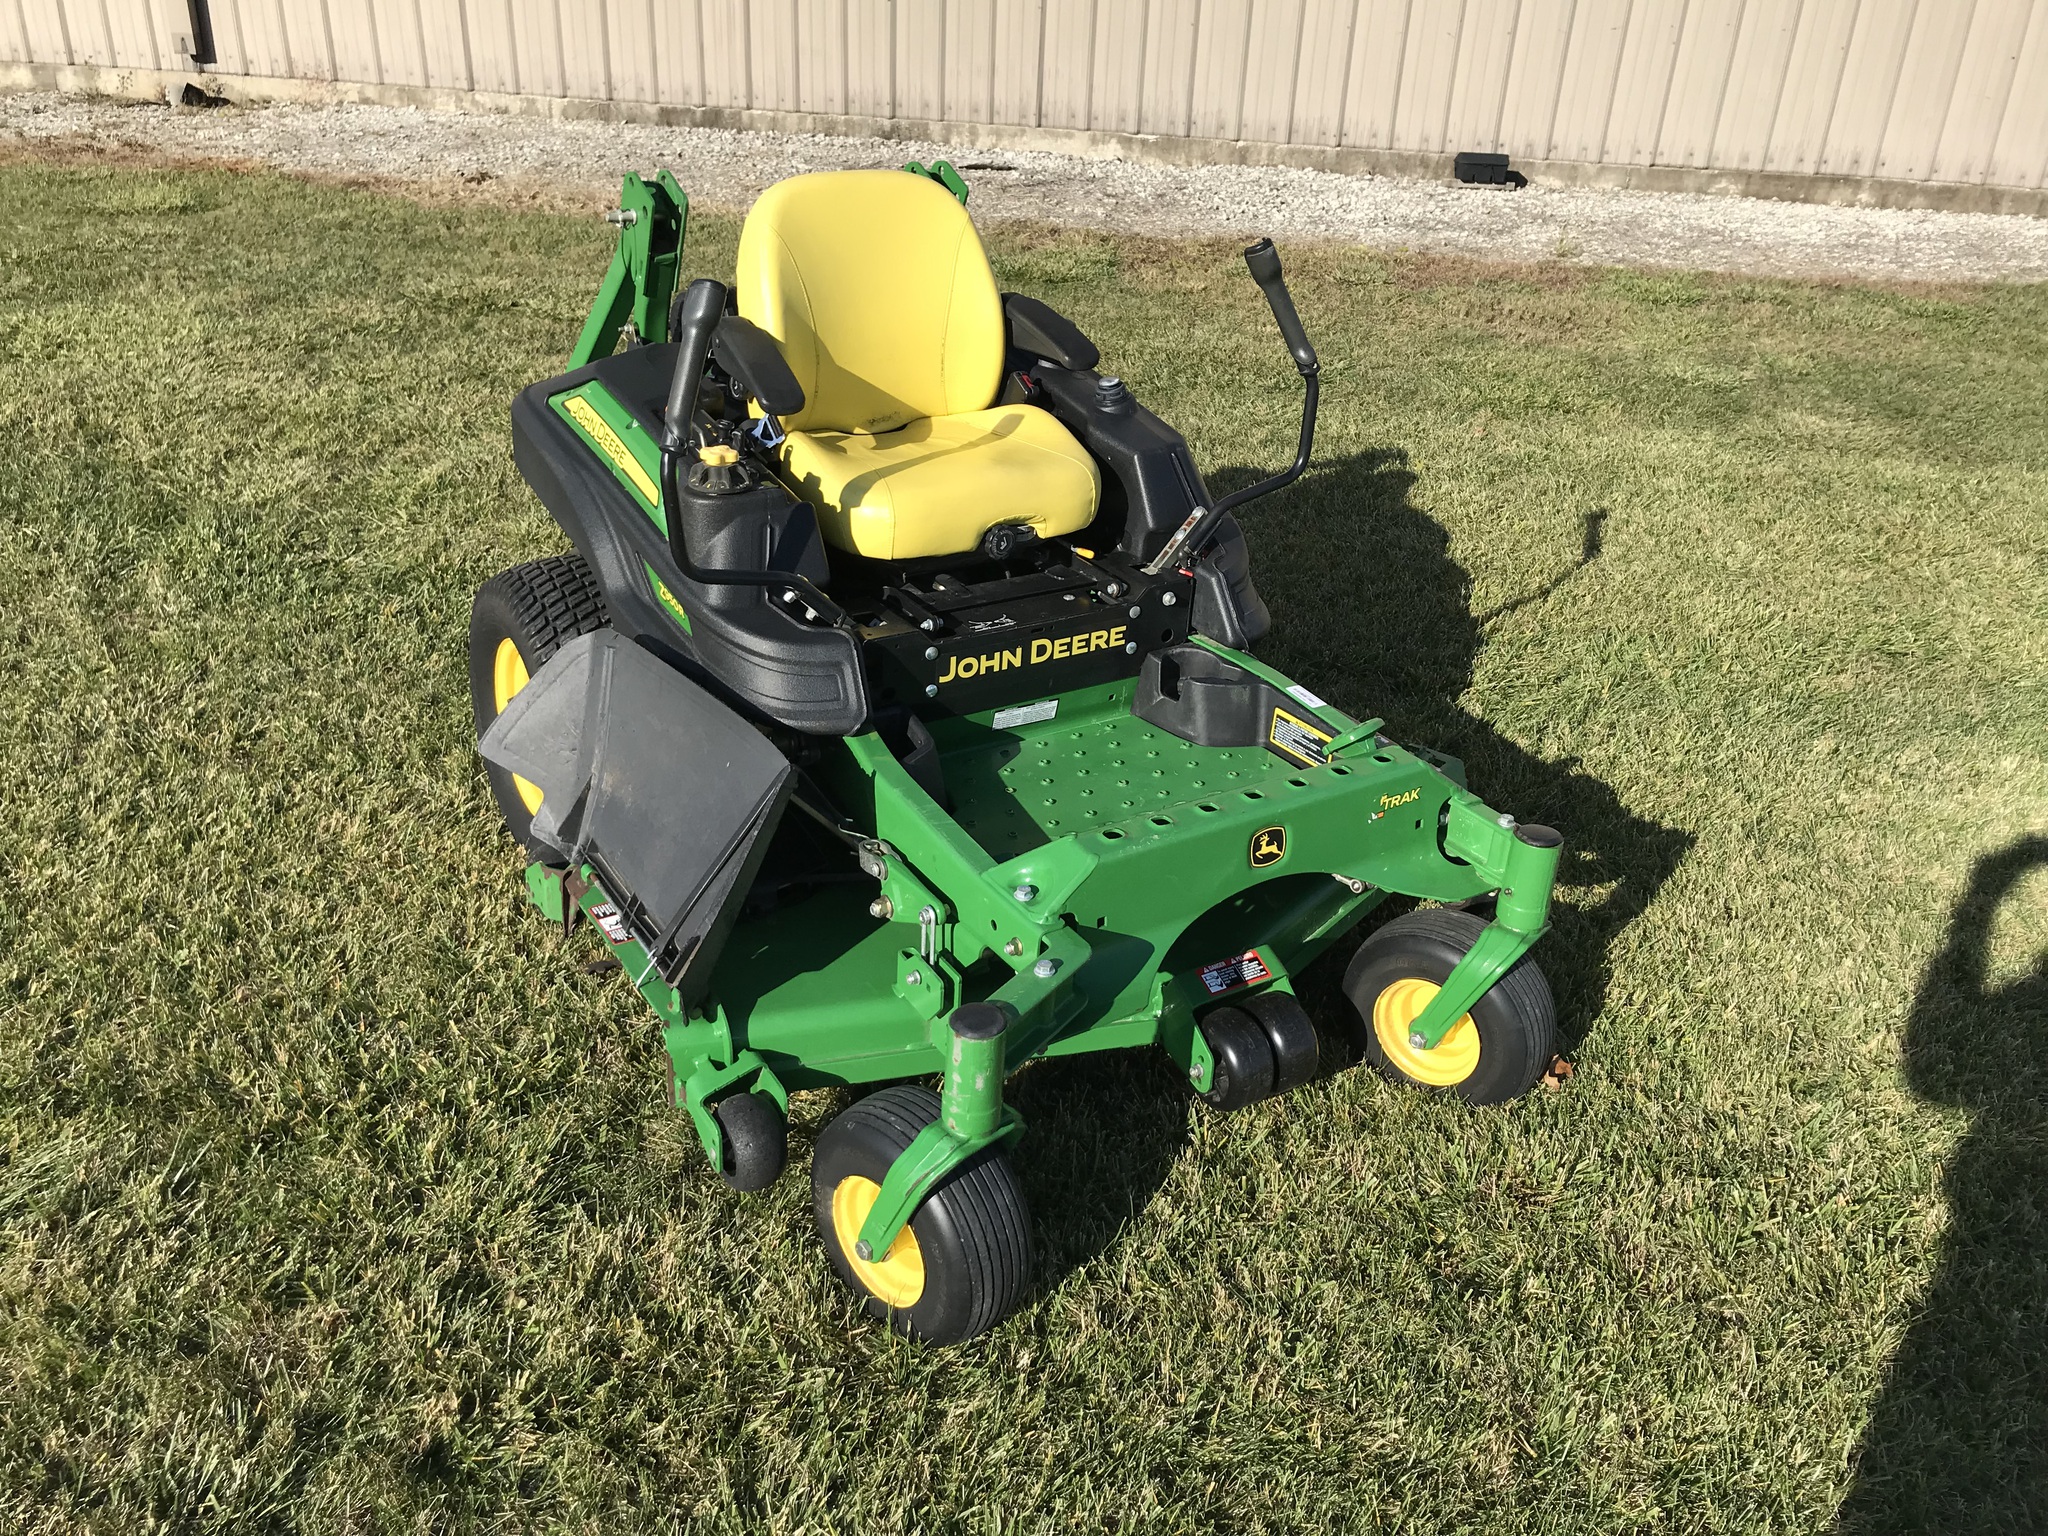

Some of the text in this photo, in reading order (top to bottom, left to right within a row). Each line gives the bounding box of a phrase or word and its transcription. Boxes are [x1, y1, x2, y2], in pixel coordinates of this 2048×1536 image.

[572, 401, 627, 466] JOHN DEERE
[938, 625, 1127, 683] JOHN DEERE
